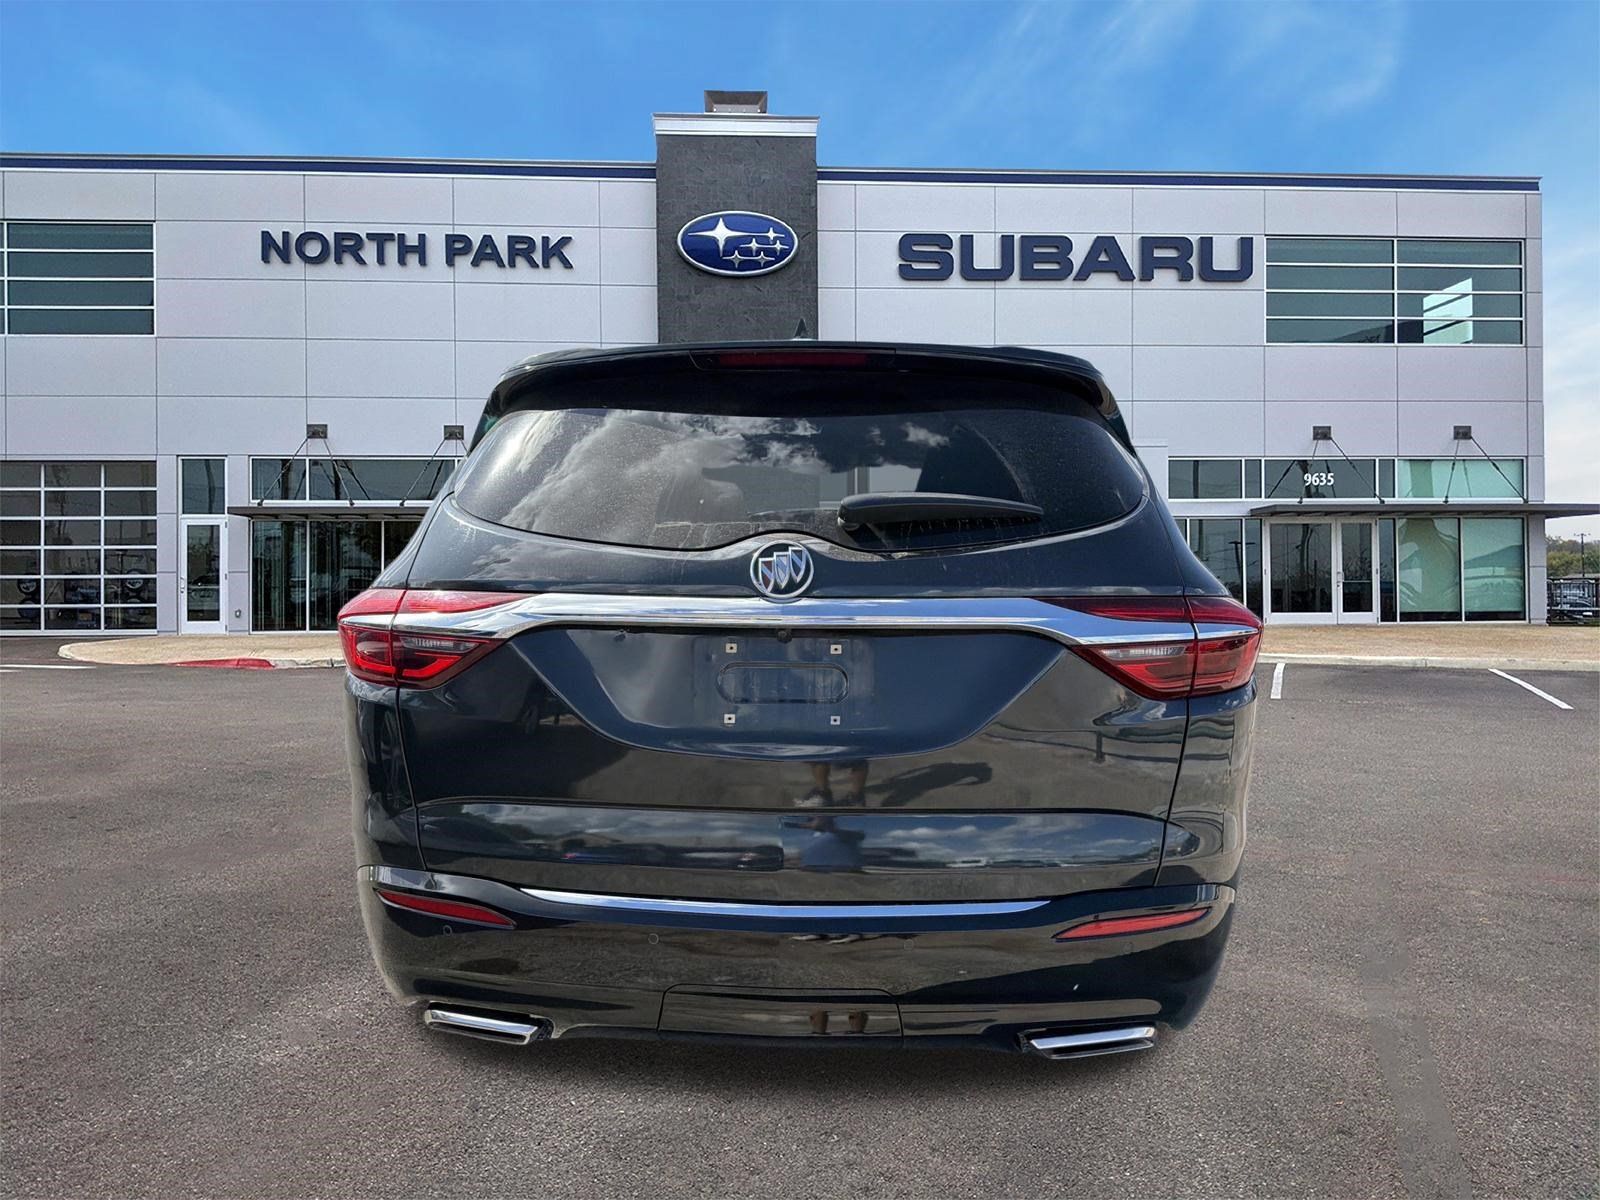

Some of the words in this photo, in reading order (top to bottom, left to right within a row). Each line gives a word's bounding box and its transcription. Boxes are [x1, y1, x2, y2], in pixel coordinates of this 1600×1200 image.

[261, 230, 427, 266] NORTH
[445, 233, 574, 269] PARK
[898, 232, 1254, 283] SUBARU
[1303, 472, 1335, 486] 9635
